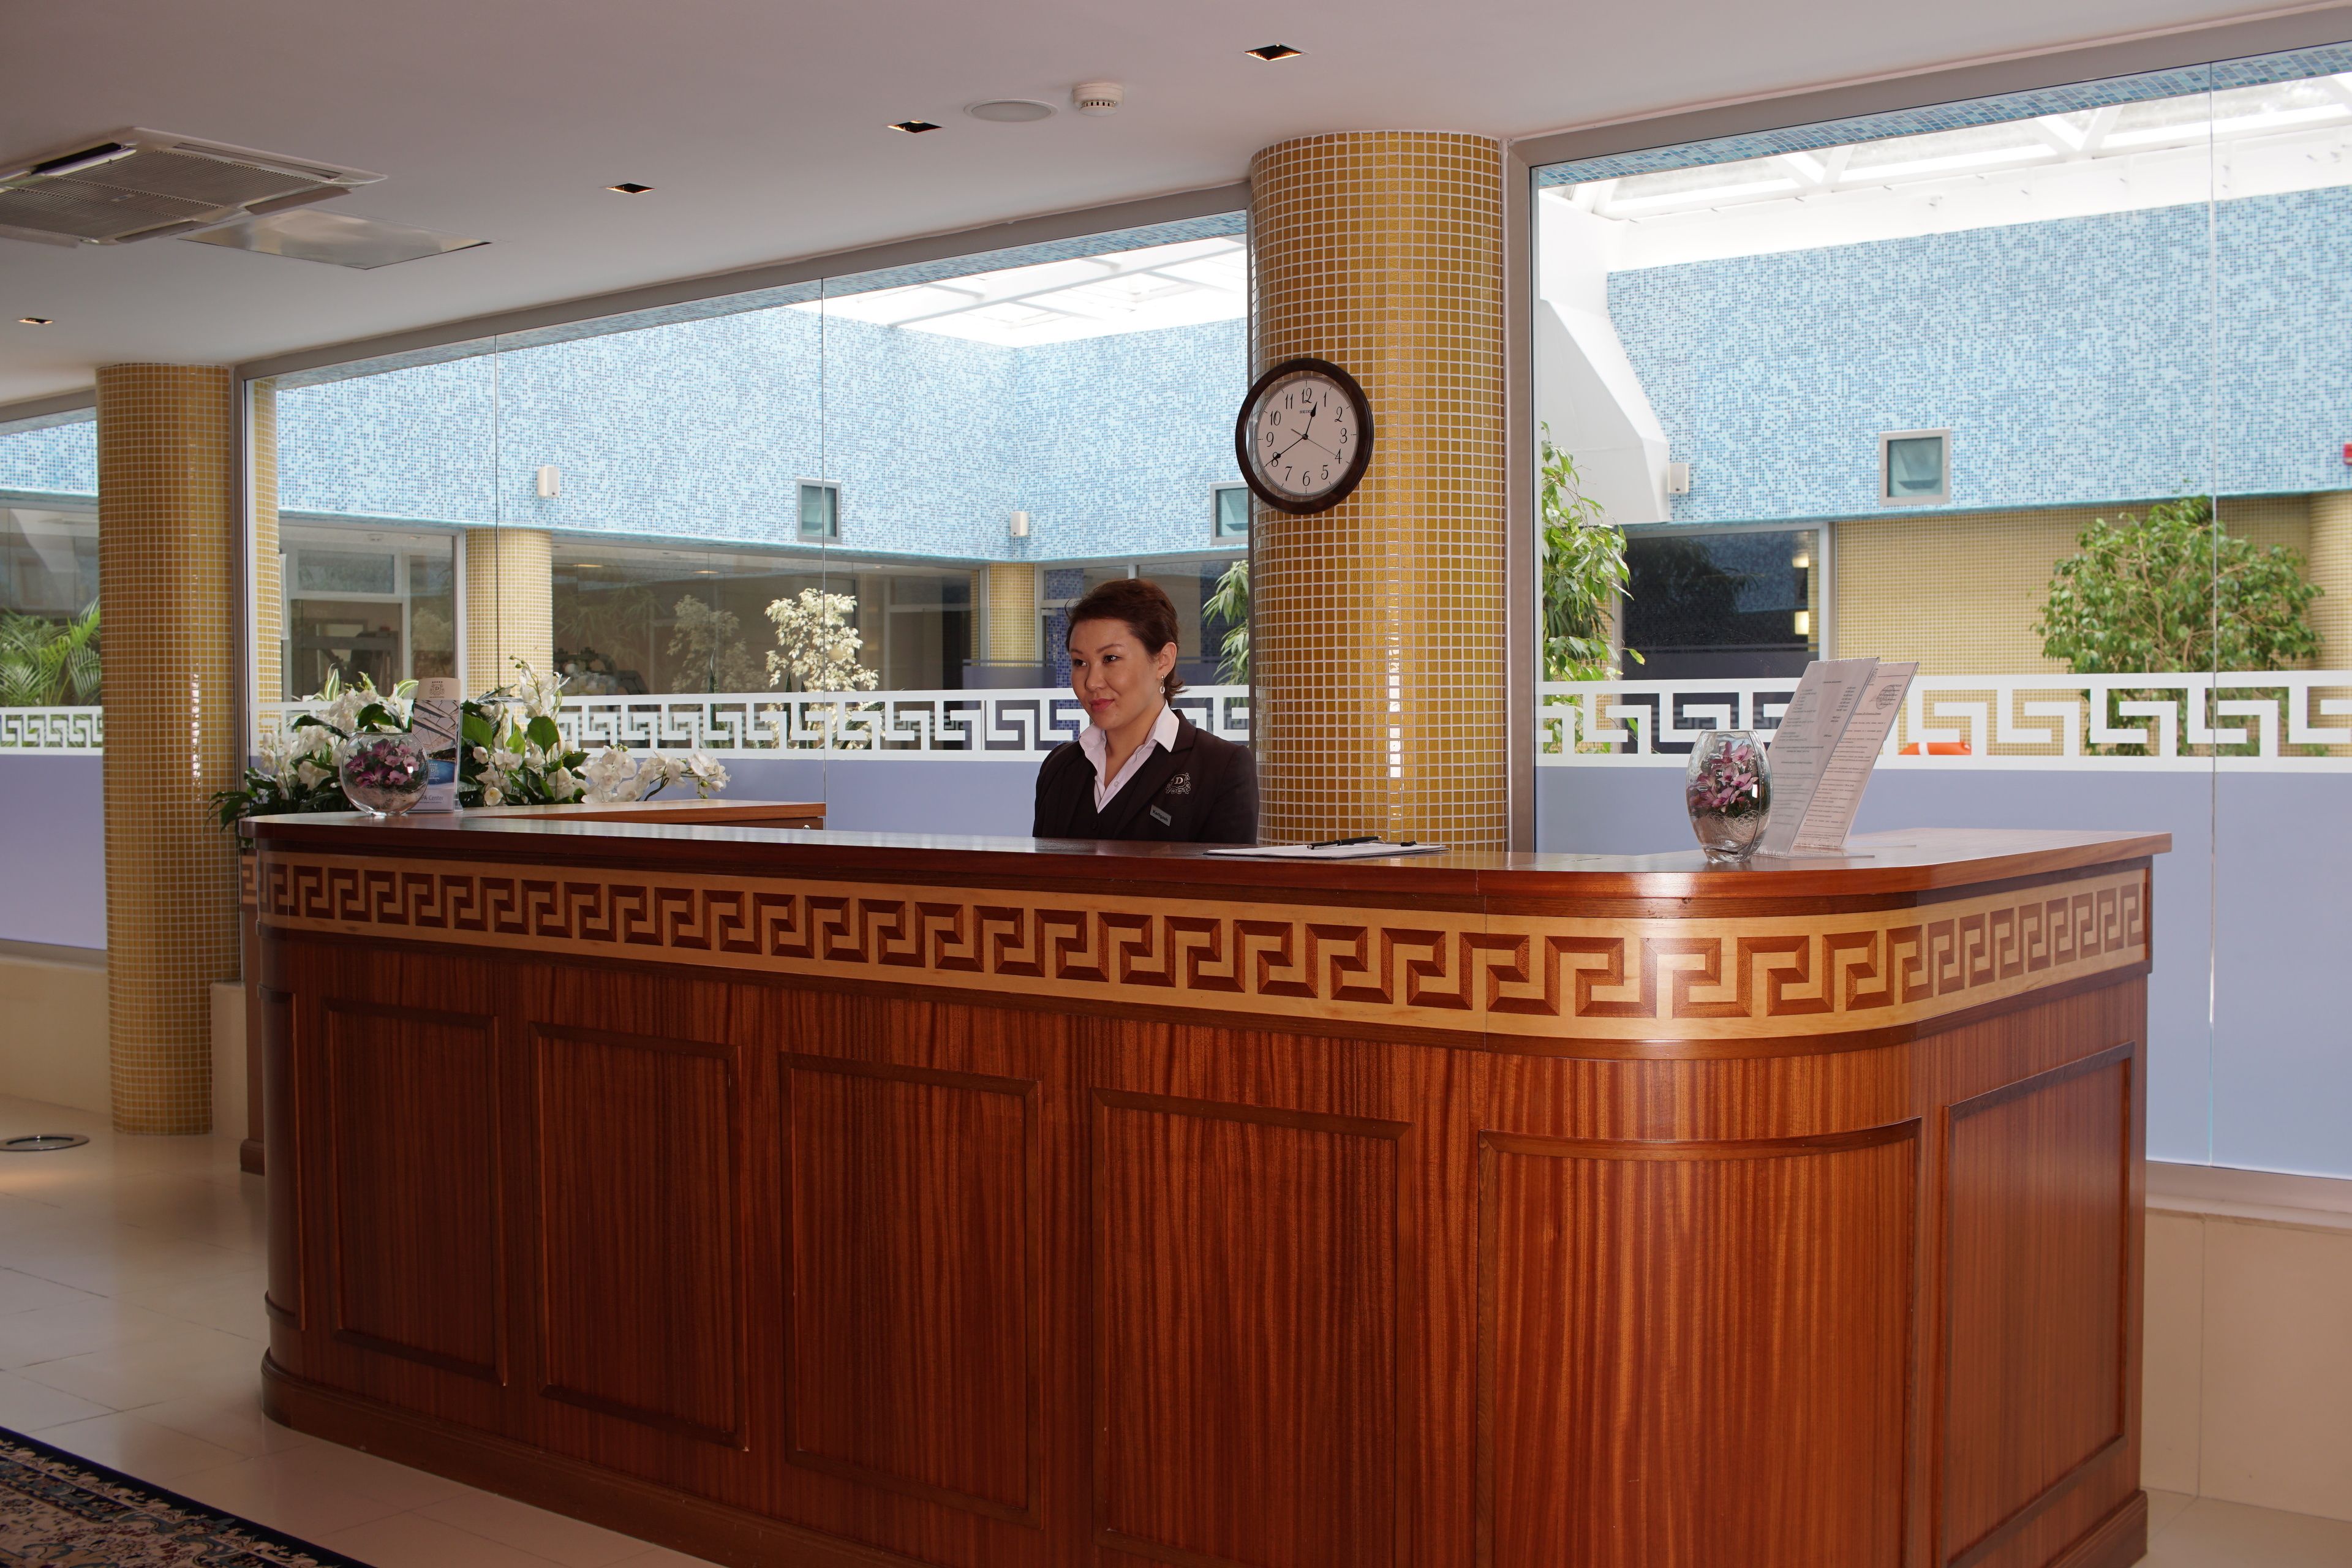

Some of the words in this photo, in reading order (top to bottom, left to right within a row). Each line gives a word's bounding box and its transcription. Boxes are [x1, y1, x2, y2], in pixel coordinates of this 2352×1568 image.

[1285, 394, 1294, 409] 11
[1302, 388, 1312, 404] 12
[1323, 392, 1327, 407] 1
[1270, 410, 1281, 426] 10
[1334, 407, 1343, 422] 2
[1266, 432, 1274, 447] 9
[1340, 428, 1348, 443] 3
[1271, 451, 1279, 467] 8
[1334, 448, 1342, 464] 4
[1285, 466, 1292, 481] 7
[1302, 471, 1310, 486] 6
[1321, 465, 1329, 480] 5
